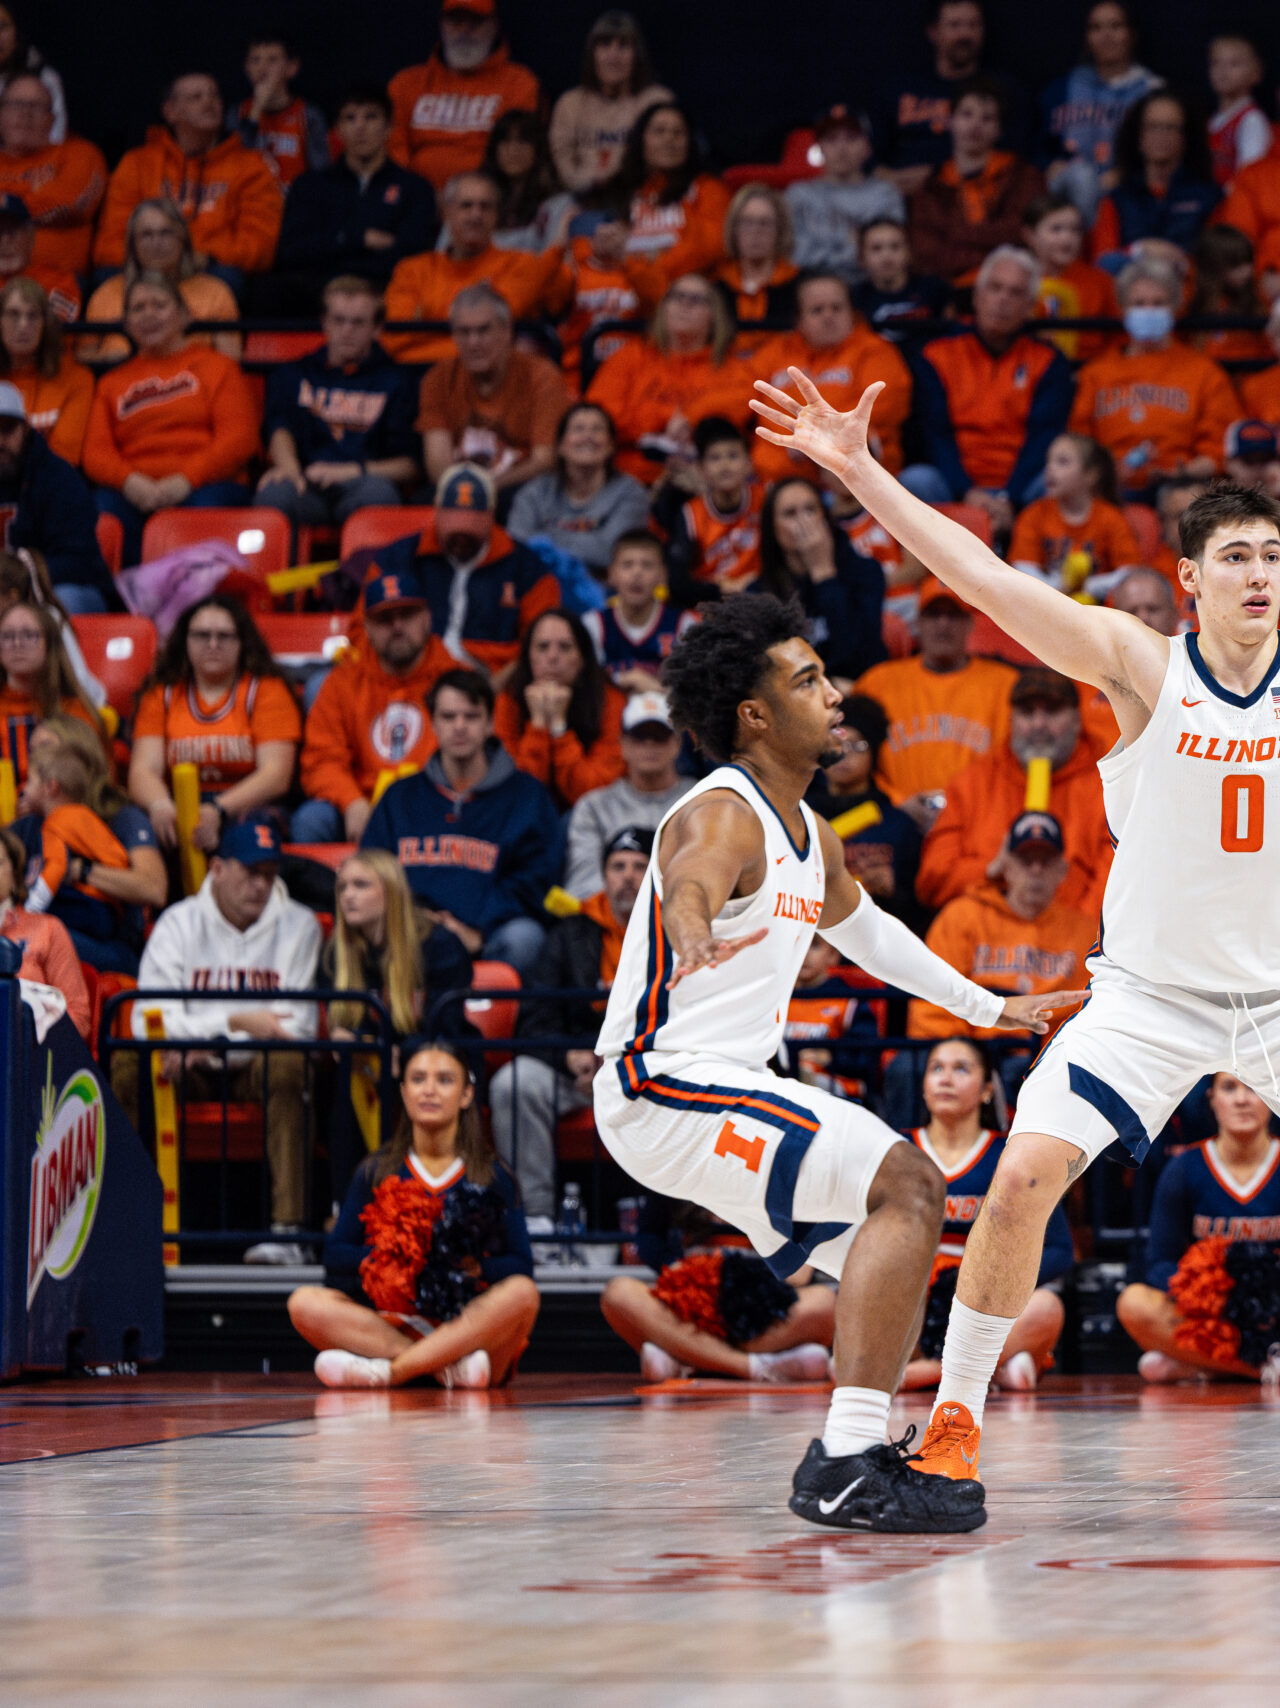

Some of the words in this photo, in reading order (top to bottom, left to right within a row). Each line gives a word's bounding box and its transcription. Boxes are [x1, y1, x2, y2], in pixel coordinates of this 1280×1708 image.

[887, 713, 991, 755] ILLINOIS
[1221, 773, 1265, 854] 0
[398, 833, 501, 874] ILLINOIS
[773, 891, 824, 925] ILLINS
[971, 945, 1076, 980] ILLINOIS
[27, 1102, 99, 1290] LIBMAN
